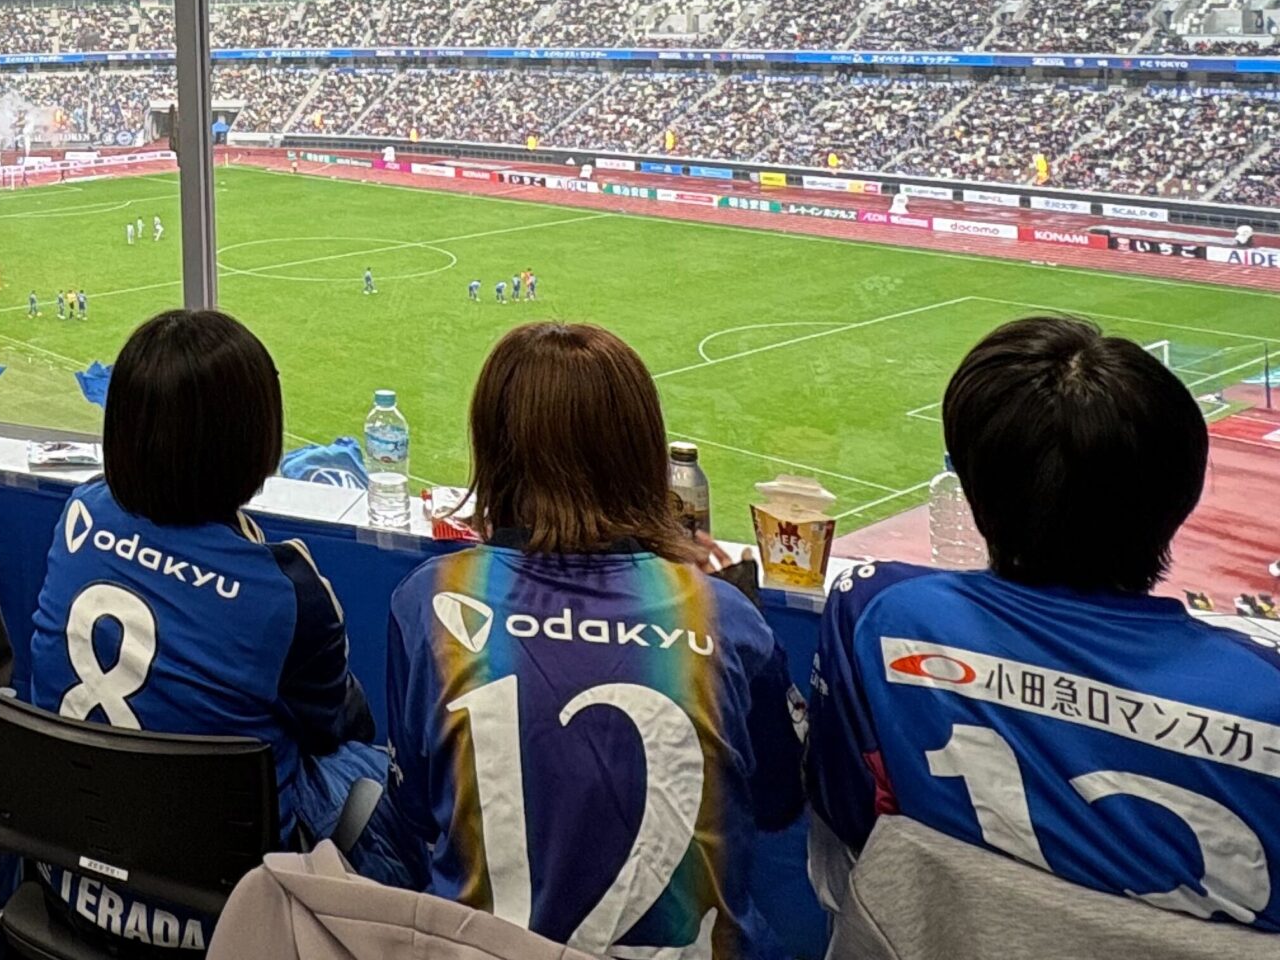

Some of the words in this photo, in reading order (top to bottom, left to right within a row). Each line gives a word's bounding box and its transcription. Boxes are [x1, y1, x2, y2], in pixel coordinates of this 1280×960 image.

[950, 221, 1000, 236] docomo
[1033, 229, 1089, 245] KONAMI
[1135, 240, 1197, 258] いちご
[93, 533, 241, 600] odakyu
[505, 608, 715, 656] odakyu
[58, 583, 157, 731] 8
[446, 674, 718, 957] 12
